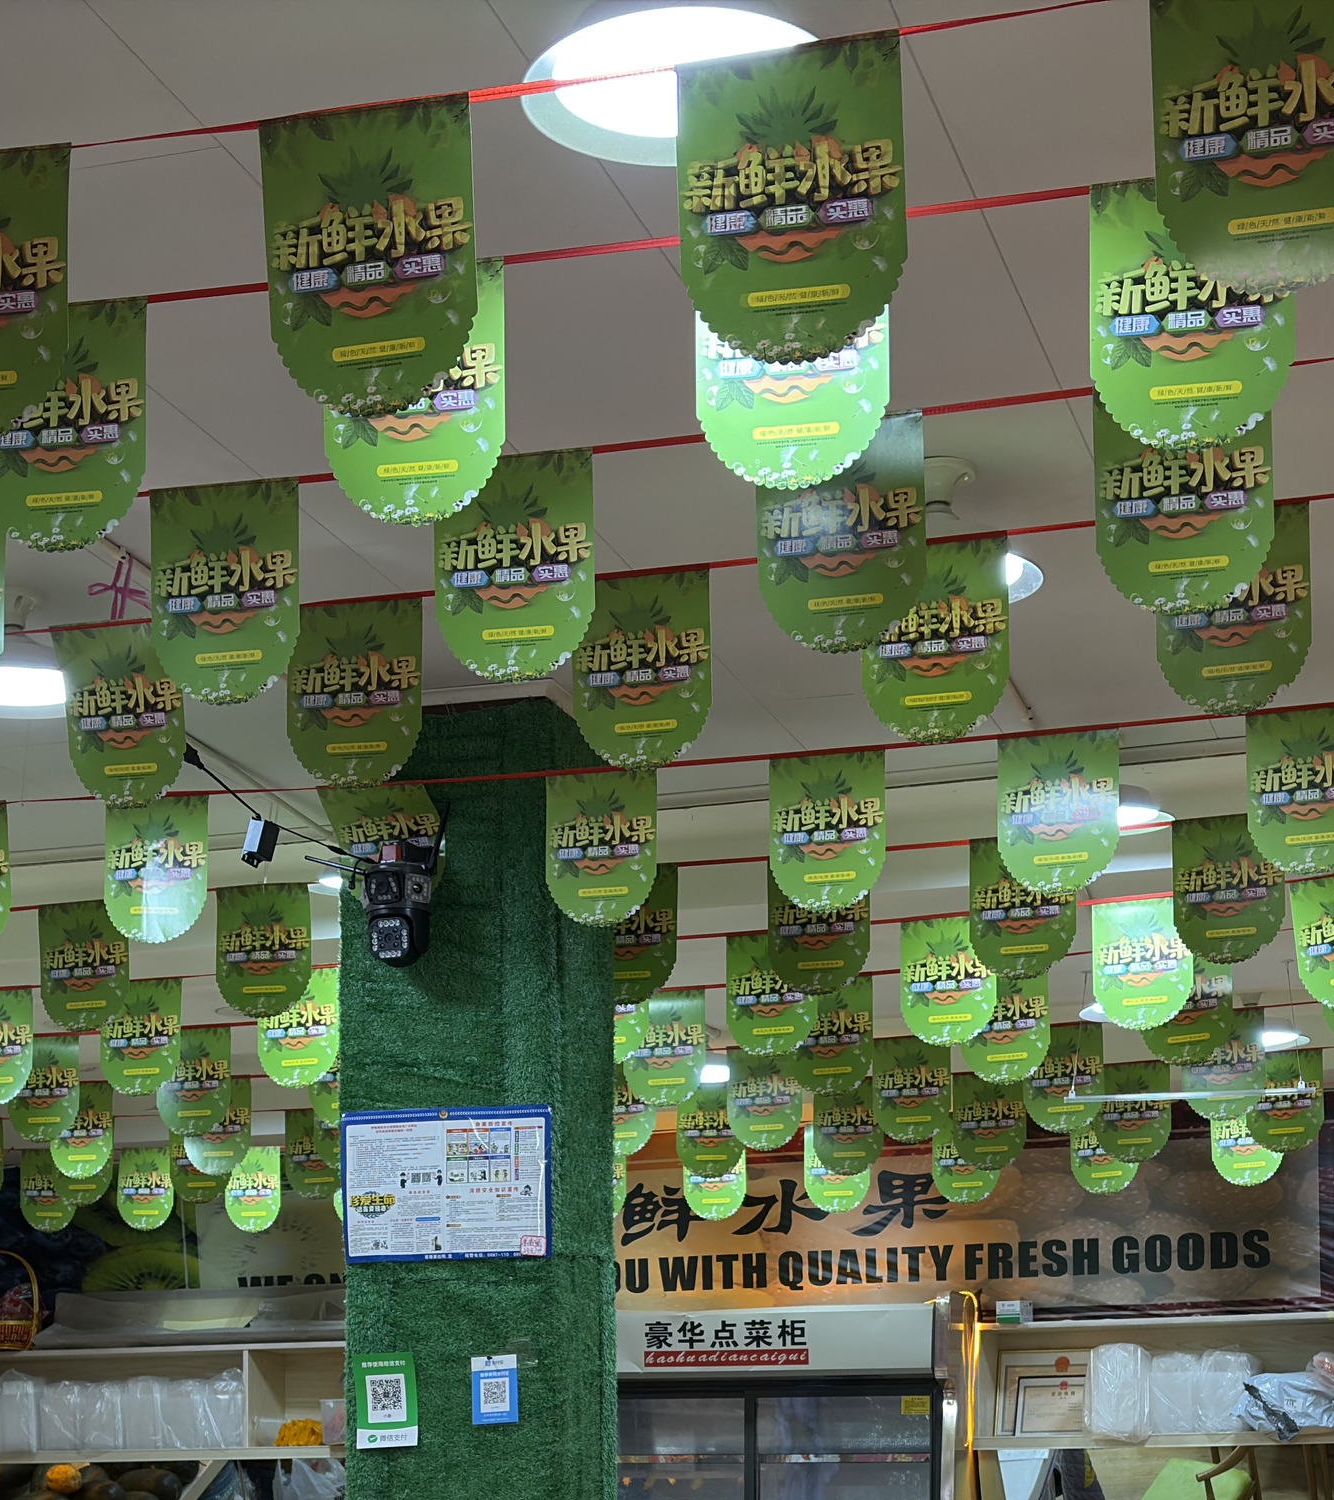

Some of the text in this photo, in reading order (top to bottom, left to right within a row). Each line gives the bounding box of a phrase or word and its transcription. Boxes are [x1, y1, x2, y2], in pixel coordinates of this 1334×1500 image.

[1184, 135, 1225, 158] 健康
[1246, 125, 1292, 150] 精品
[684, 139, 903, 212] 新鲜水果
[707, 198, 869, 233] 健康 精品 实惠
[271, 197, 472, 270] 新鲜水果
[293, 254, 442, 290] 健康 精品 实惠
[1099, 446, 1271, 500] 新鲜水果
[1117, 490, 1244, 515] 健康 精品 实惠
[439, 522, 592, 571] 新鲜水果
[155, 549, 297, 597] 新鲜水果
[454, 564, 568, 585] 健康 精品 实惠
[169, 590, 275, 611] 健康 精品 实惠
[577, 628, 710, 672] 新鲜水果
[292, 655, 421, 694] 新鲜水果
[69, 677, 181, 717] 新鲜水果
[549, 815, 656, 848] 新鲜水果
[773, 797, 884, 832] 新鲜水果
[1176, 859, 1283, 892] 新鲜水果
[43, 941, 128, 969] 新鲜水果
[219, 925, 310, 952] 新鲜水果
[658, 1252, 768, 1292] WITH
[778, 1244, 954, 1291] QUALITY
[967, 1236, 1093, 1282] FRESH
[1112, 1229, 1271, 1275] GOODS
[644, 1319, 808, 1350] 豪华点菜柜
[645, 1350, 807, 1366] haohuadiancaigui
[380, 1434, 408, 1442] 微信支付
